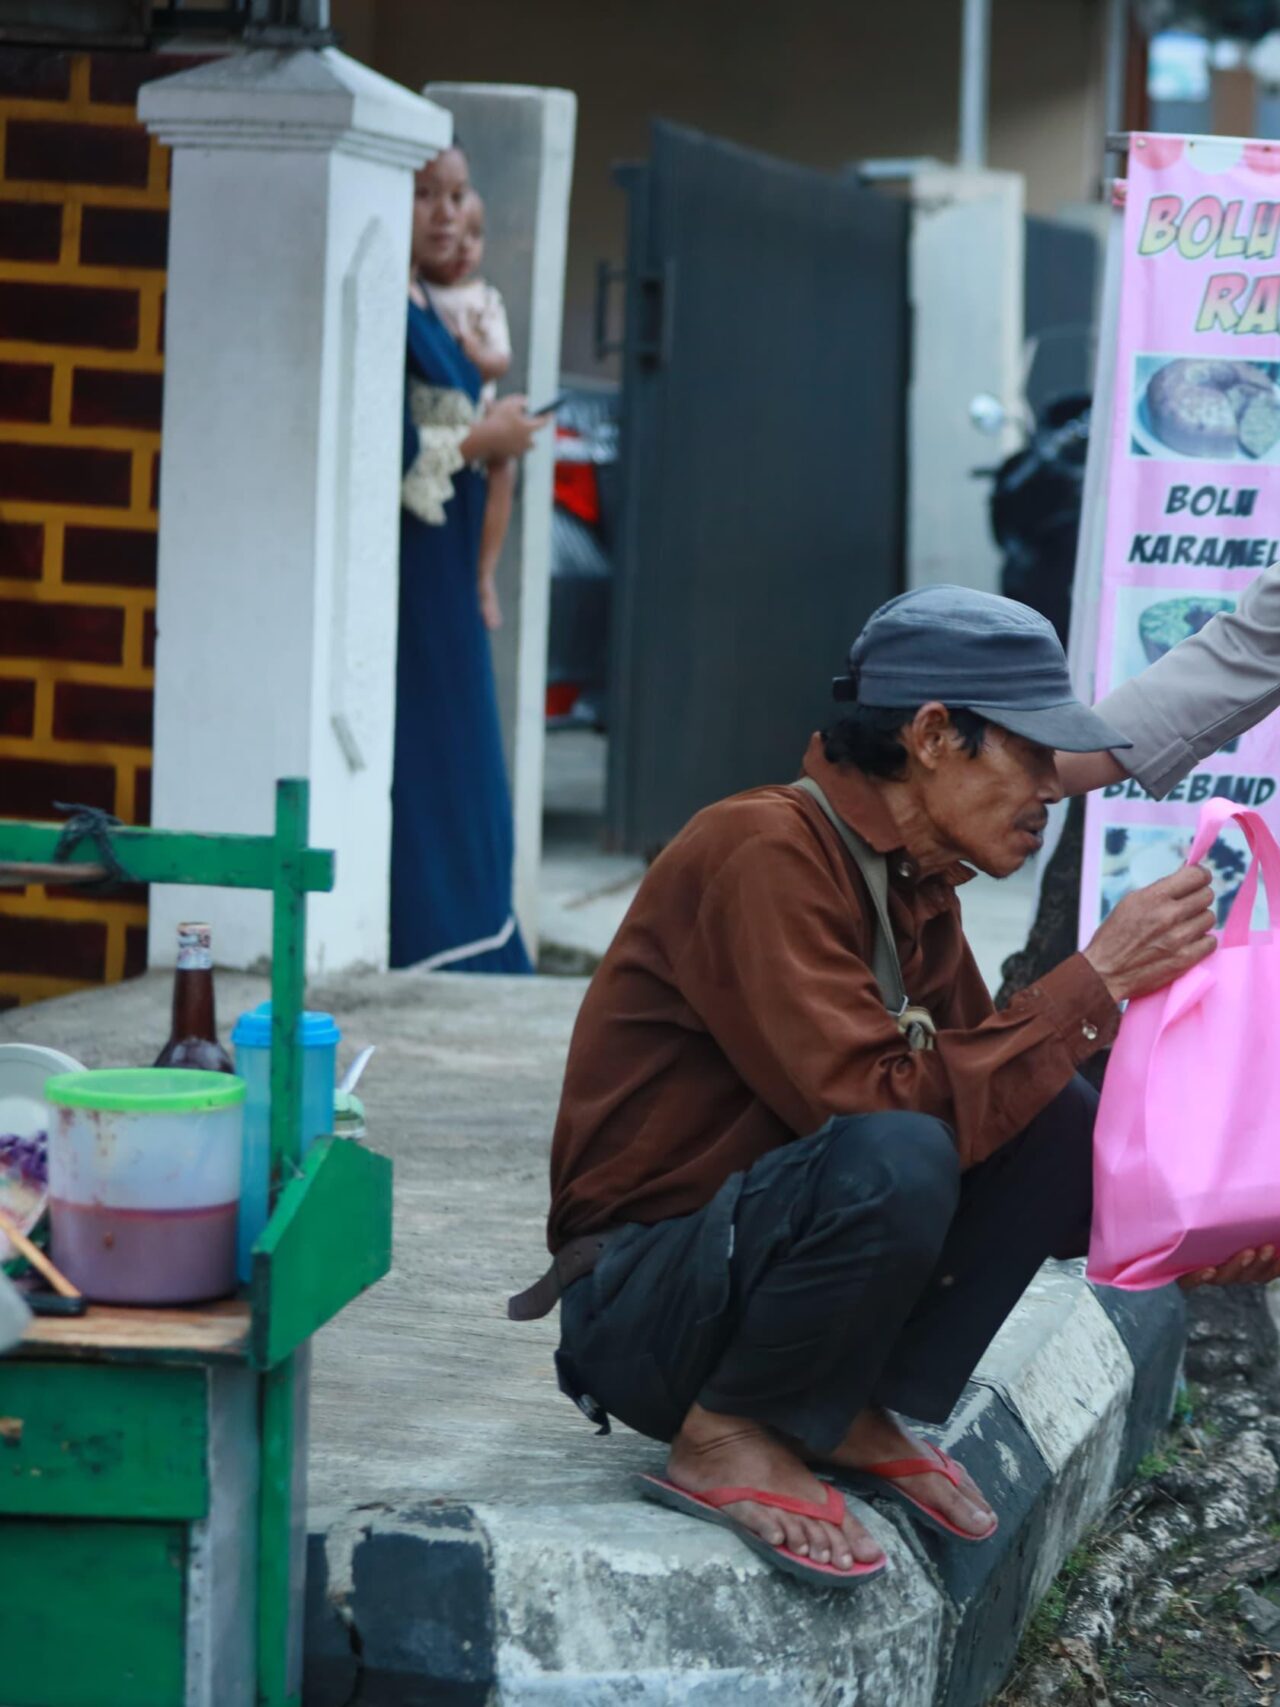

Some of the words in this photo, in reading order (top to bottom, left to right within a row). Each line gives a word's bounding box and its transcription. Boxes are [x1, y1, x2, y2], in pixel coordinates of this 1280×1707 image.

[1164, 484, 1258, 517] BOLU
[1128, 534, 1279, 568] KARAMEL
[1103, 773, 1276, 806] BLEBAND
